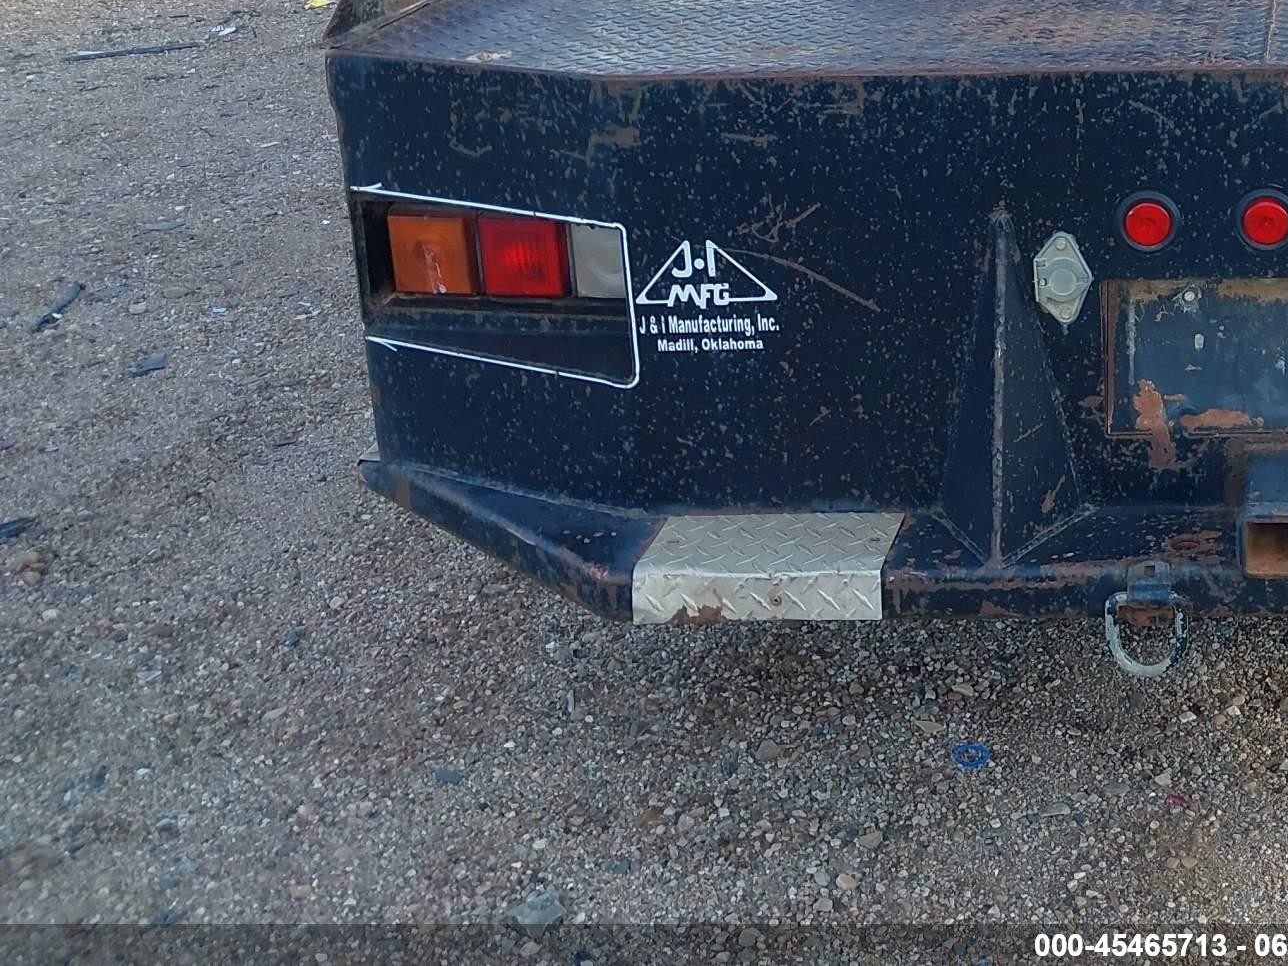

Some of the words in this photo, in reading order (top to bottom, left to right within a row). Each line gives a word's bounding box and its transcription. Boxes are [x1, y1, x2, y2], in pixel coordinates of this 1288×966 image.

[667, 283, 730, 309] MFG
[639, 316, 646, 334] J
[650, 316, 658, 334] &
[668, 314, 755, 336] Manufacturing,
[757, 313, 780, 332] Inc.
[657, 339, 698, 353] Madill,
[701, 338, 764, 351] Oklahoma
